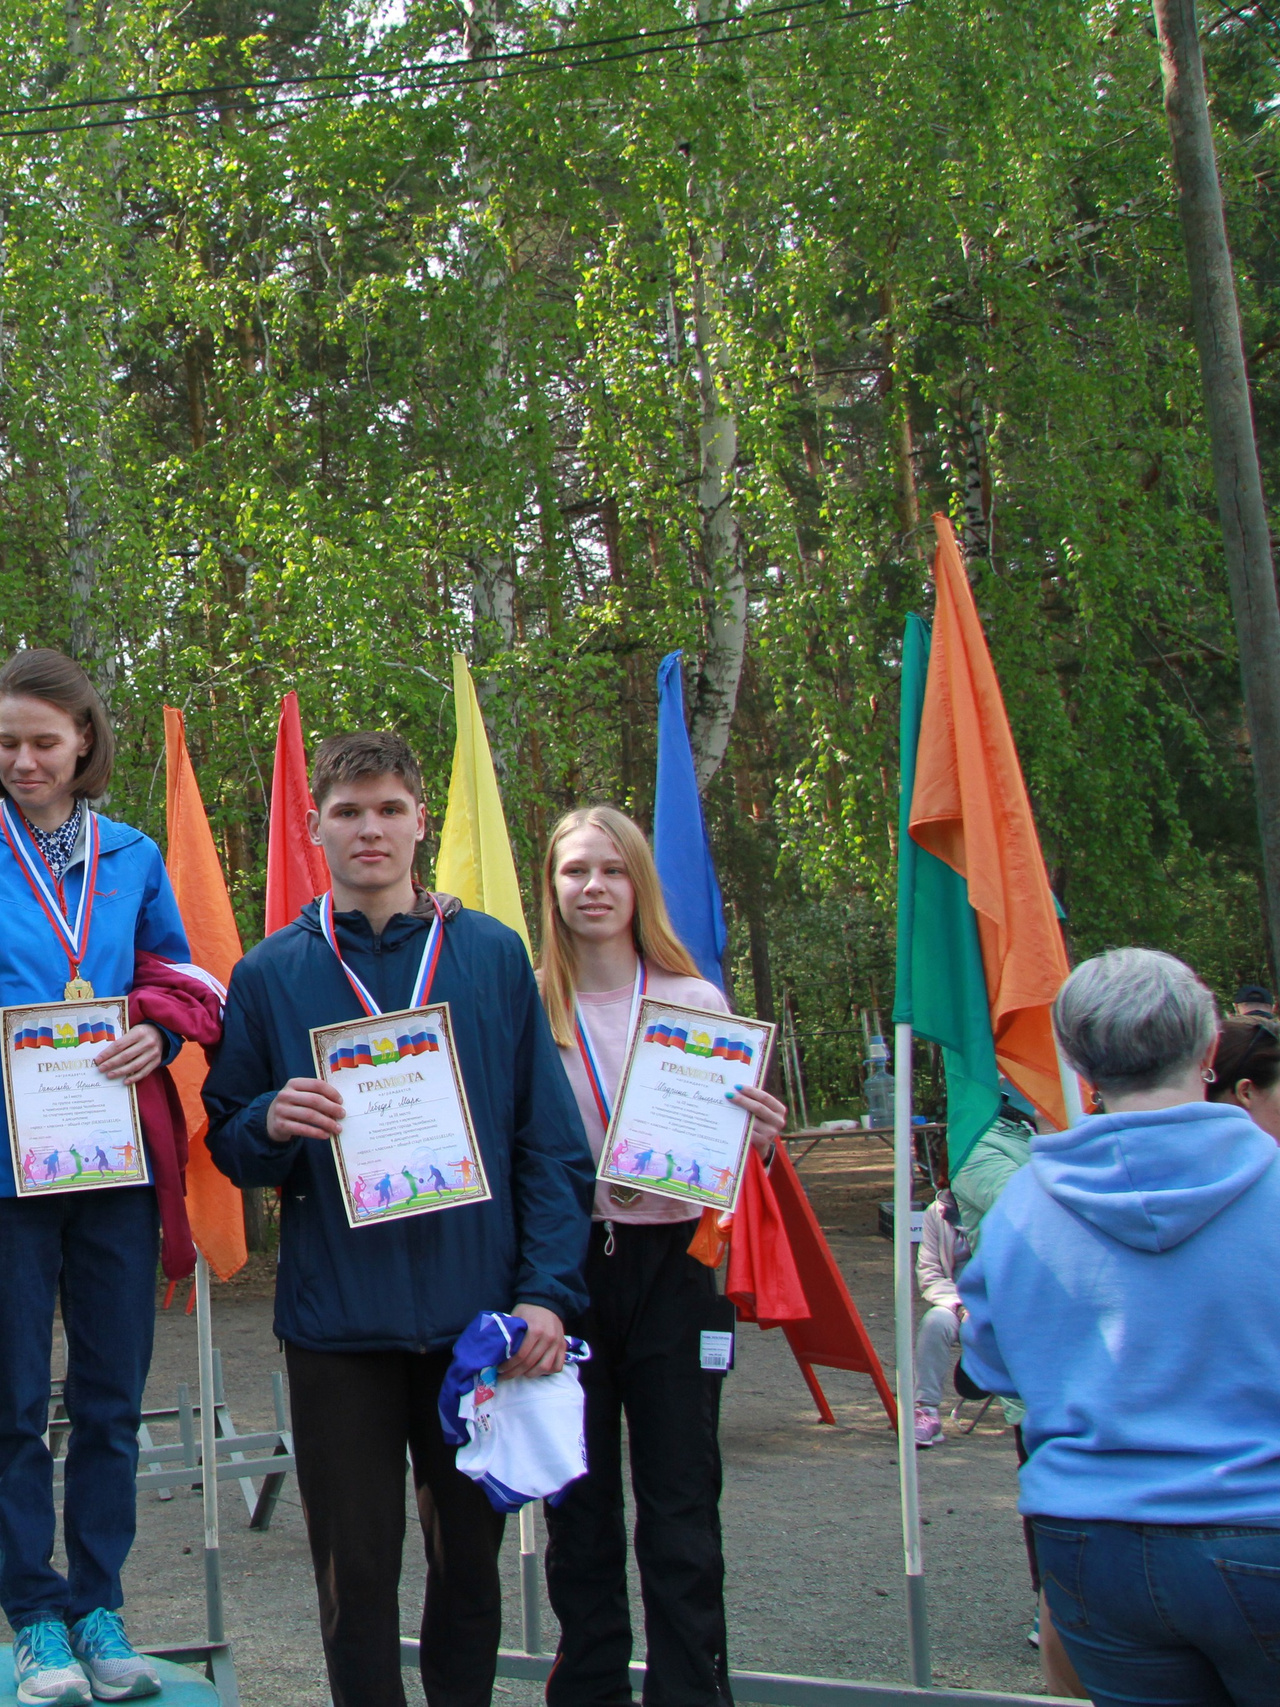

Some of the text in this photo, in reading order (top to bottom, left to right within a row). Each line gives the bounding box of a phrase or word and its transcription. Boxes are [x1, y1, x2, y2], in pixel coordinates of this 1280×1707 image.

[37, 1058, 99, 1073] ГРАМОТА
[660, 1061, 726, 1085] ГРАМОТА
[38, 1080, 102, 1093] Васильева Ирина
[357, 1071, 425, 1094] ГРАМОТА
[364, 1096, 422, 1117] Лебедев Марк
